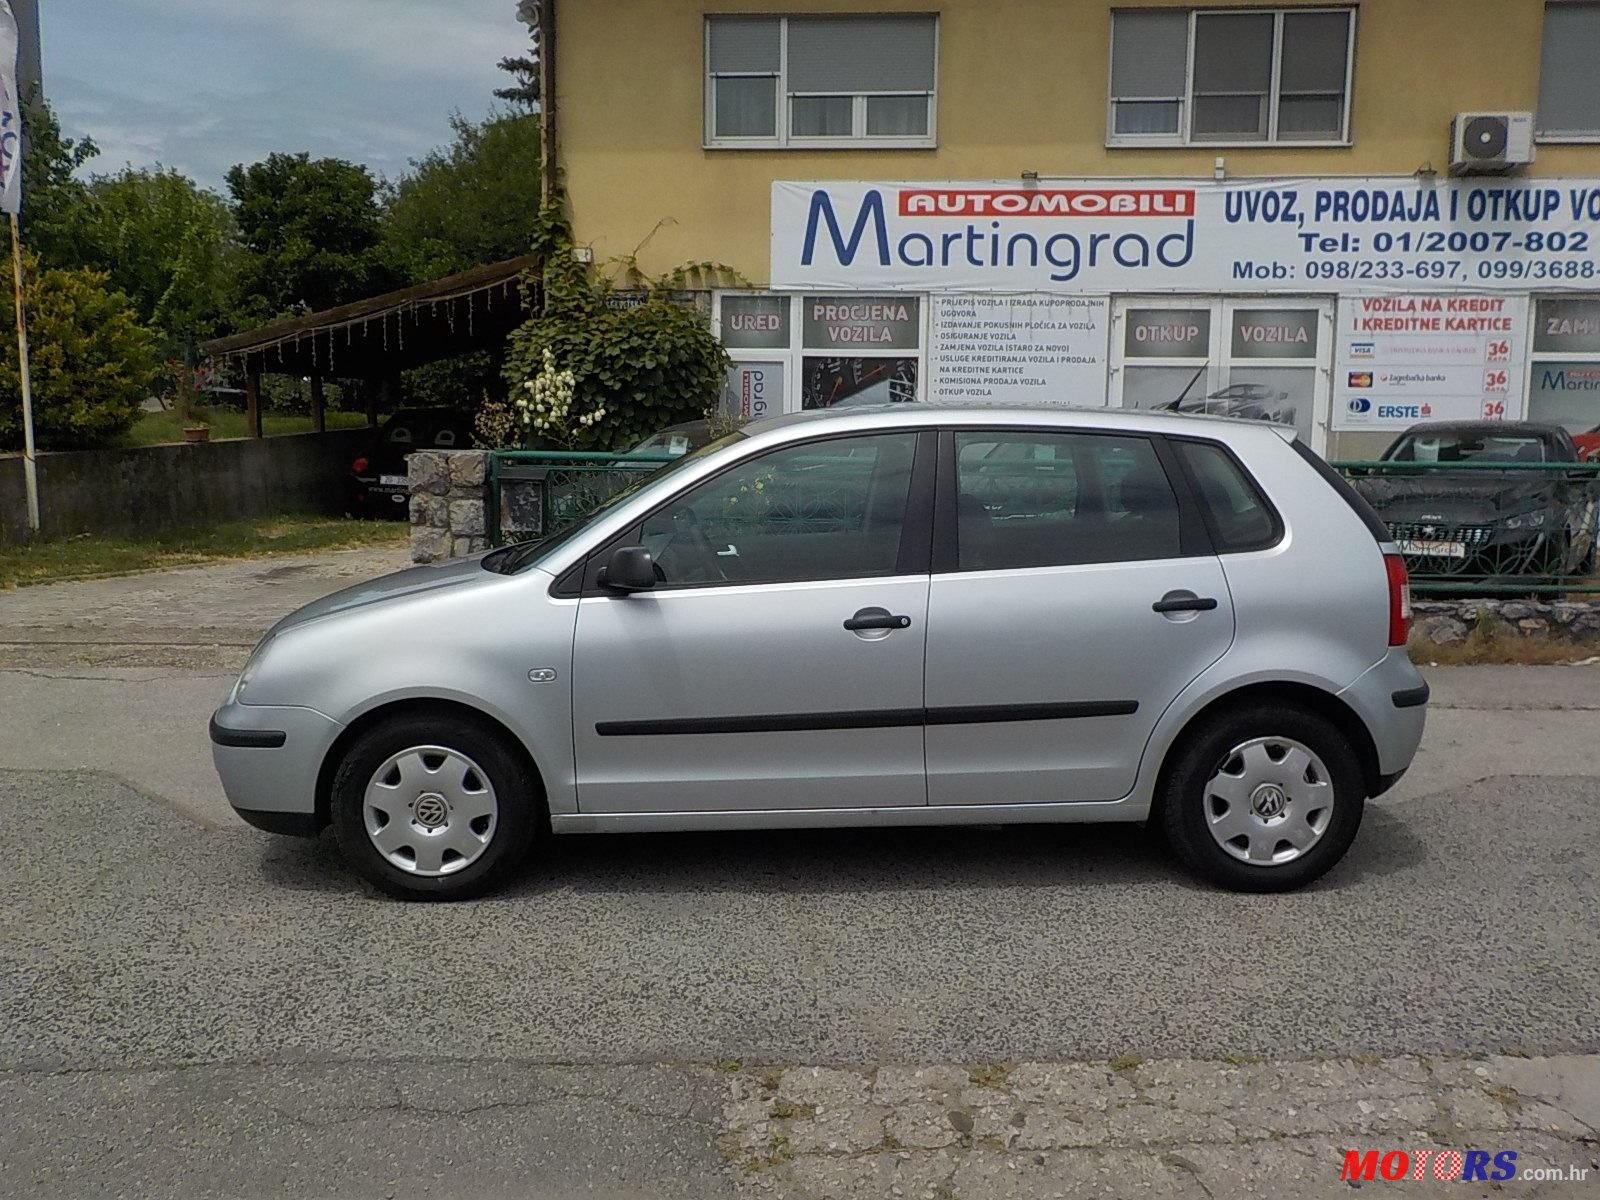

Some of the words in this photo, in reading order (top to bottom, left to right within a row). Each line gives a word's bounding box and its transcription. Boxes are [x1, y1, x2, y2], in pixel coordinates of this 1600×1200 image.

[907, 194, 1186, 213] AUTOMOBILI
[1224, 190, 1306, 229] UVOZ,
[1314, 189, 1440, 222] PRODAJA
[1449, 189, 1458, 221] I
[1467, 188, 1560, 222] OTKUP
[801, 189, 1195, 281] Martingrad
[1298, 232, 1360, 252] Tel:
[1373, 231, 1589, 252] 01/2007-802
[1232, 261, 1296, 279] Mob:
[1305, 260, 1468, 282] 098/233-697,
[941, 298, 976, 306] PRIJEPIS
[1010, 299, 1037, 307] IZRADA
[1039, 299, 1104, 307] KUPOPRODAJNIH
[1362, 298, 1416, 312] VOZILA
[1421, 298, 1443, 312] NA
[1447, 298, 1505, 312] KREDIT
[813, 304, 909, 321] PROCJENA
[731, 314, 780, 330] URED
[941, 321, 982, 329] IZDAVANJE
[983, 321, 1023, 329] POKUSNIH
[1025, 320, 1056, 330] PLOČICA
[1057, 322, 1067, 330] ZA
[1069, 322, 1096, 330] VOZILA
[1353, 317, 1358, 331] I
[1362, 317, 1440, 331] KREDITNE
[1445, 317, 1512, 331] KARTICE
[828, 326, 893, 342] VOZILA
[940, 332, 988, 340] OSIGURANJE
[1135, 325, 1199, 342] OTKUP
[1240, 326, 1308, 343] VOZILA
[977, 344, 1004, 352] VOZILA
[1488, 341, 1508, 356] 36
[971, 355, 1027, 363] KREDITIRANJA
[1061, 356, 1096, 364] PRODAJA
[939, 377, 982, 385] KOMISIONA
[1426, 373, 1446, 381] banka
[1486, 371, 1506, 386] 36
[939, 388, 964, 396] OTKUP
[1378, 405, 1418, 418] ERSTE
[1484, 402, 1504, 416] 36
